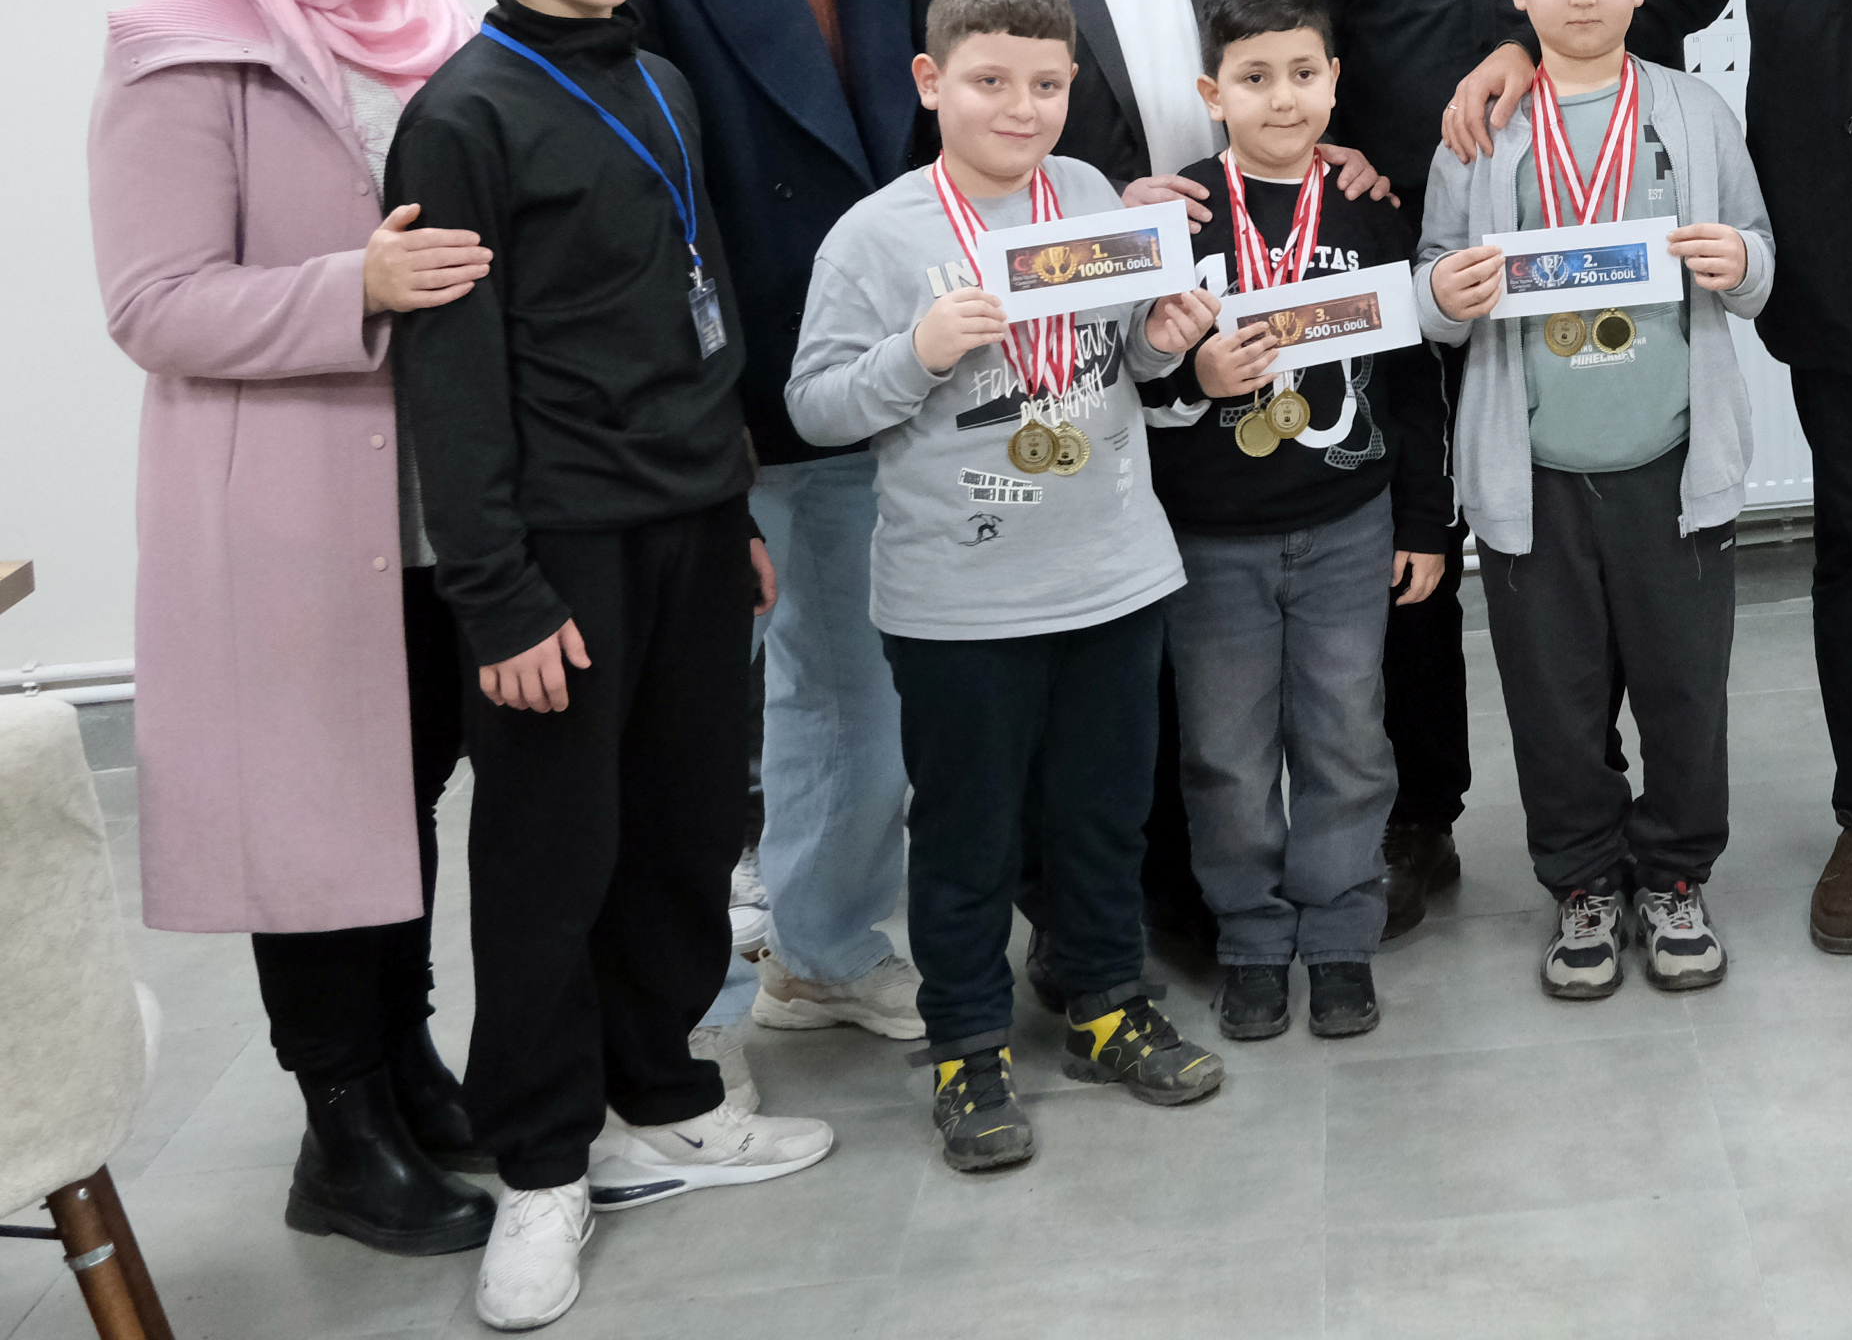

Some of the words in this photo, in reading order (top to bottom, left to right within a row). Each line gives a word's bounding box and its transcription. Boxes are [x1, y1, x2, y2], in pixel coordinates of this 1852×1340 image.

[1091, 243, 1109, 259] 1.
[1077, 260, 1114, 278] 1000
[1113, 262, 1126, 272] TL
[1126, 253, 1154, 270] ÖDÜL
[1583, 254, 1598, 268] 2.
[1572, 271, 1598, 285] 750
[1598, 271, 1610, 282] TL
[1610, 267, 1636, 281] ÖDÜL
[1315, 308, 1330, 323] 3.
[1304, 324, 1331, 340] 500
[1330, 324, 1343, 335] TL
[1343, 317, 1369, 332] ÖDÜL
